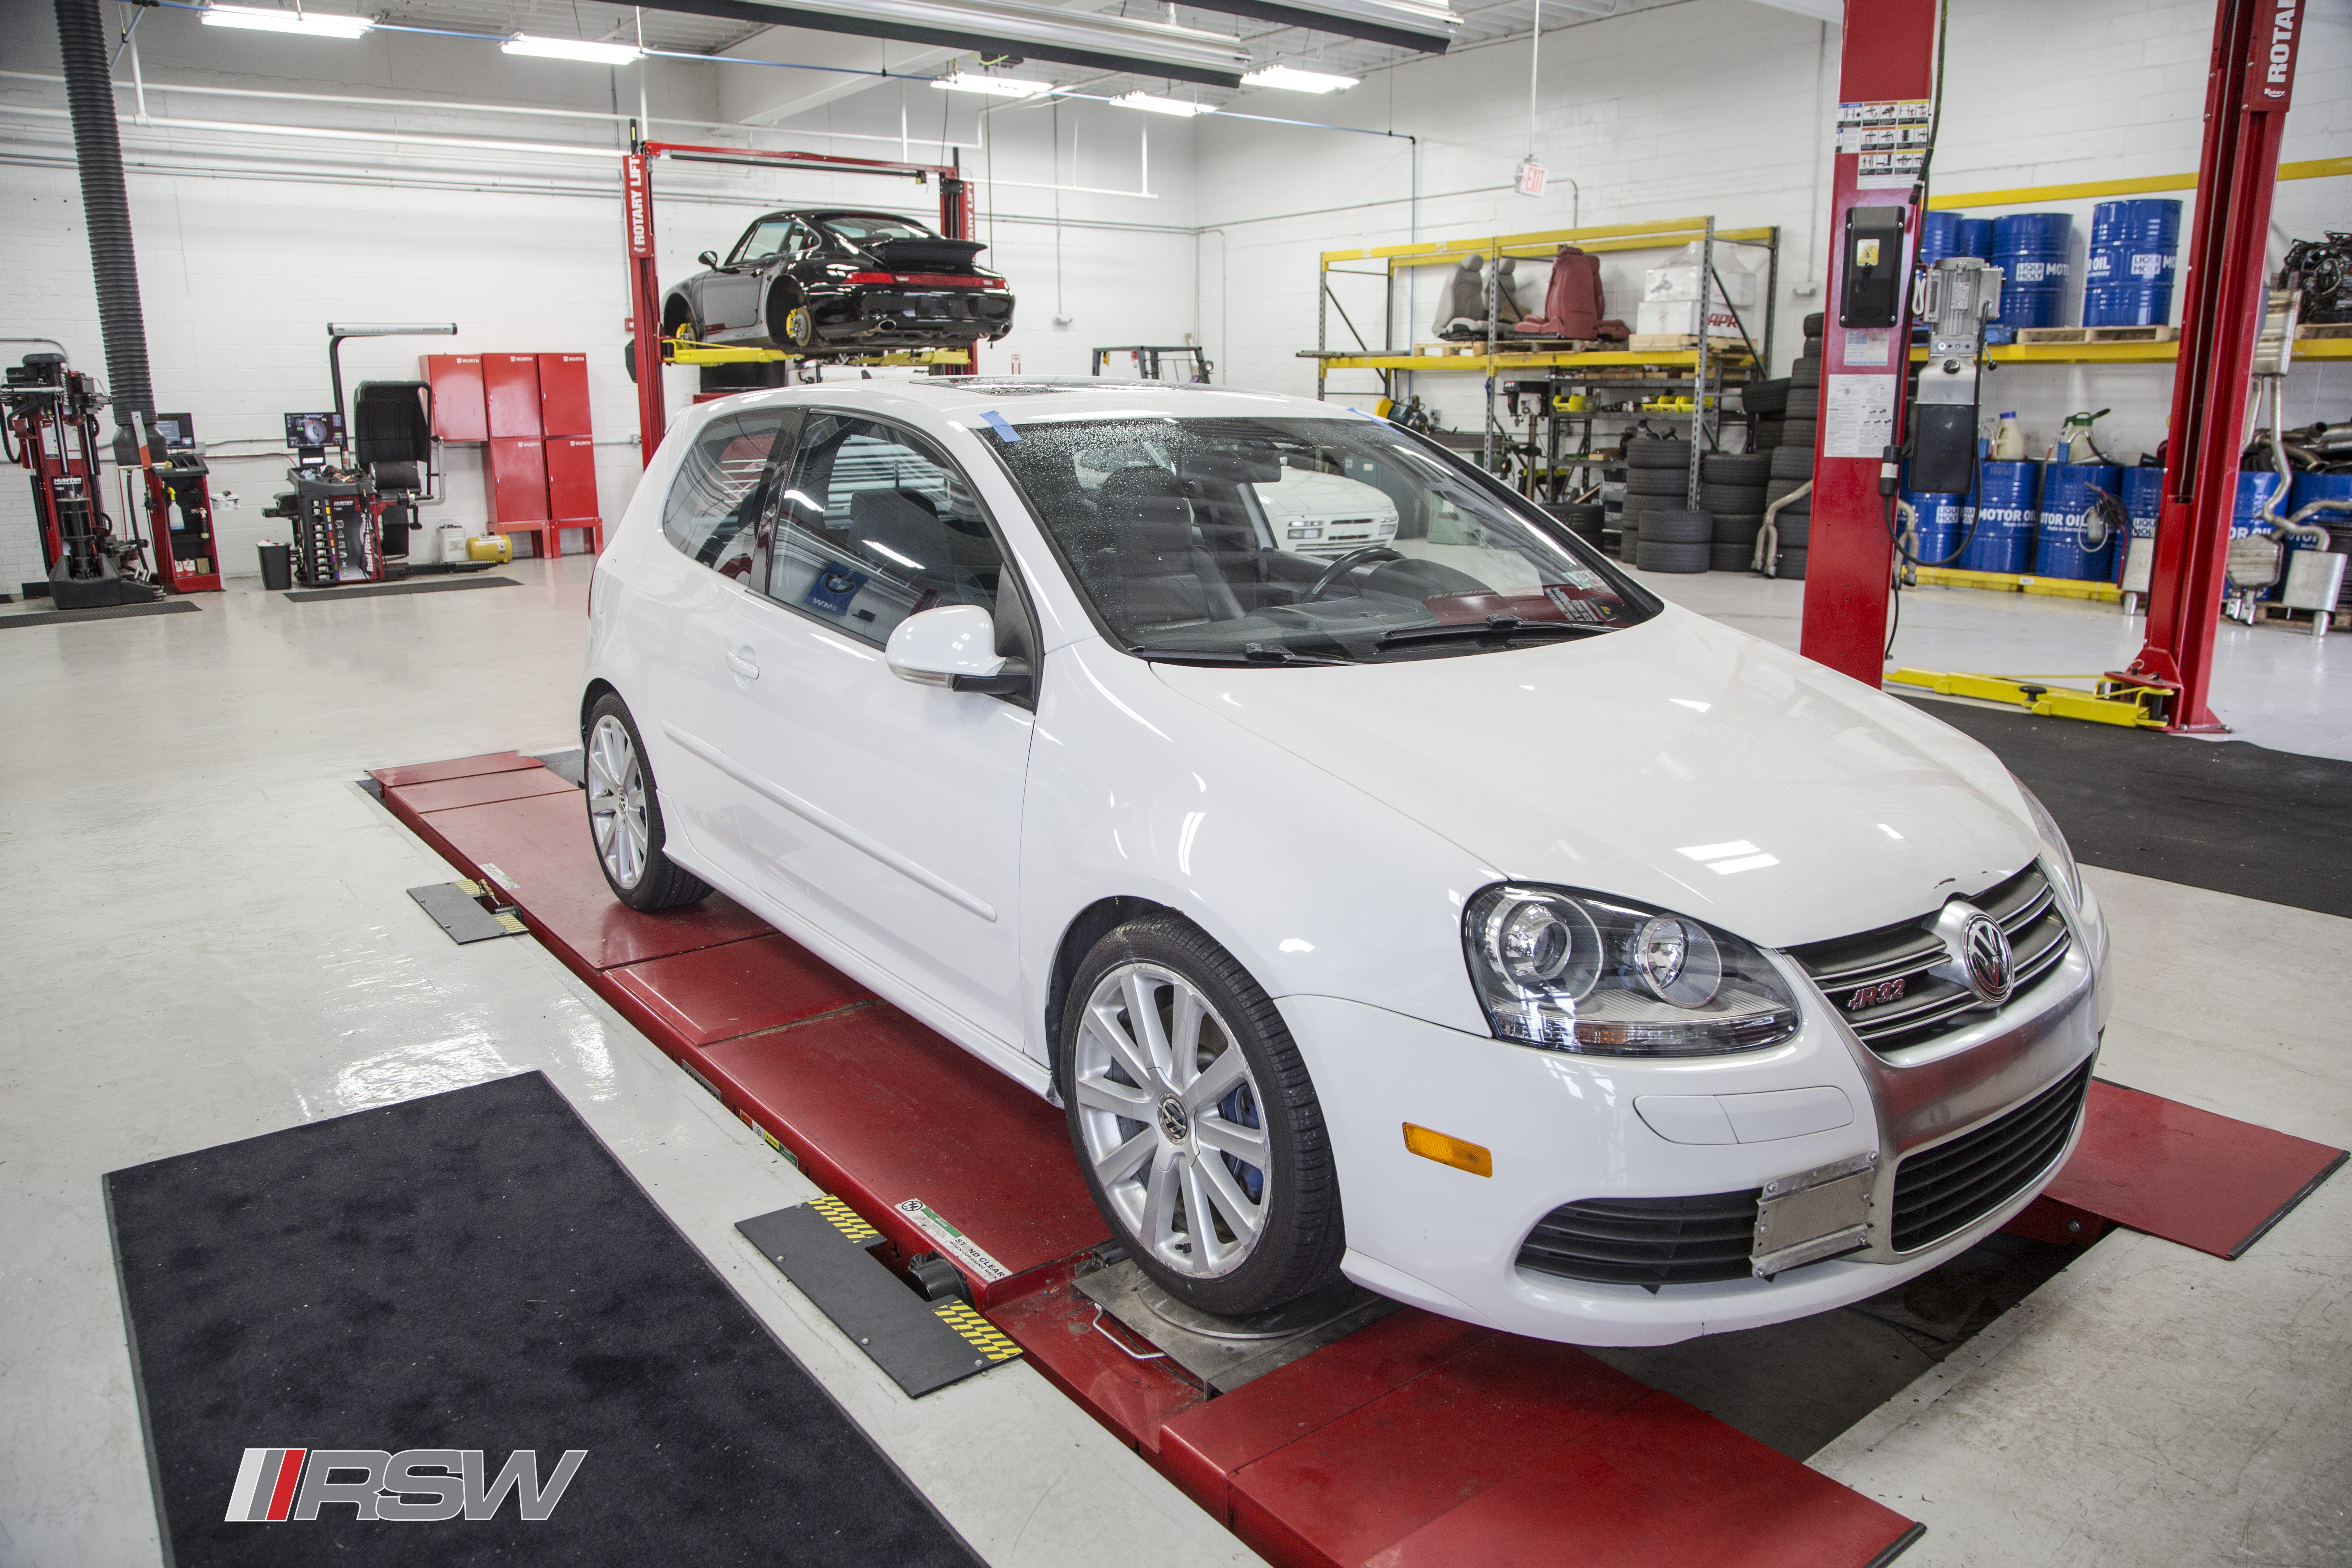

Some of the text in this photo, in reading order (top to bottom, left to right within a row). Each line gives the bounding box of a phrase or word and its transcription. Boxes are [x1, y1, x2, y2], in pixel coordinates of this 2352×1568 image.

[1526, 167, 1545, 193] EXIT
[629, 156, 645, 245] ROTARY LIFT
[2092, 256, 2111, 271] OIL
[1708, 314, 1737, 327] APR
[1979, 508, 2022, 522] MOTOR
[2065, 514, 2088, 528] OIL
[1848, 979, 1906, 1010] R32
[950, 1241, 963, 1252] WHEN
[955, 1239, 1005, 1278] STND CLEAR
